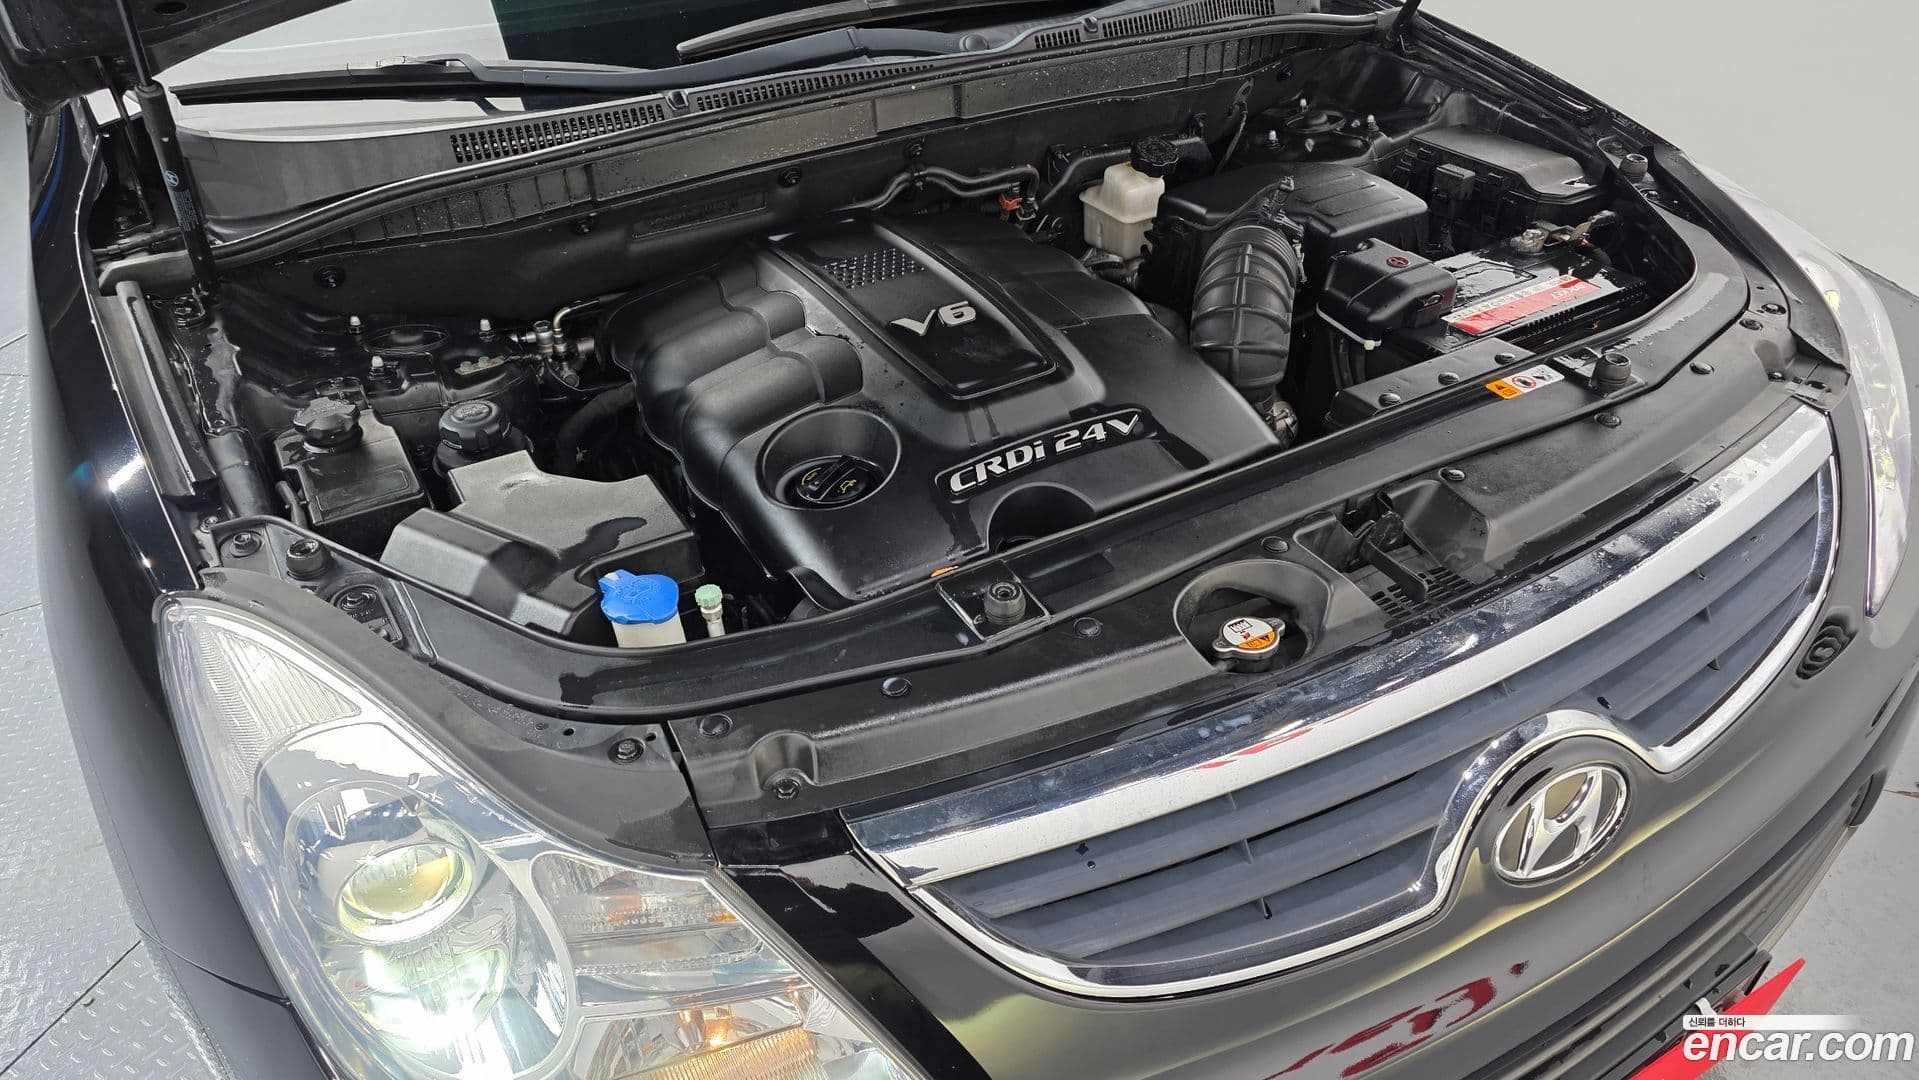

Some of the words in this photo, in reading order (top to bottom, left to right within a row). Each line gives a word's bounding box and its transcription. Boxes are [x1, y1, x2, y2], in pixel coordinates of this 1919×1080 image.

[890, 300, 977, 336] V6
[950, 440, 1046, 494] CRDi
[1053, 414, 1140, 454] 24V
